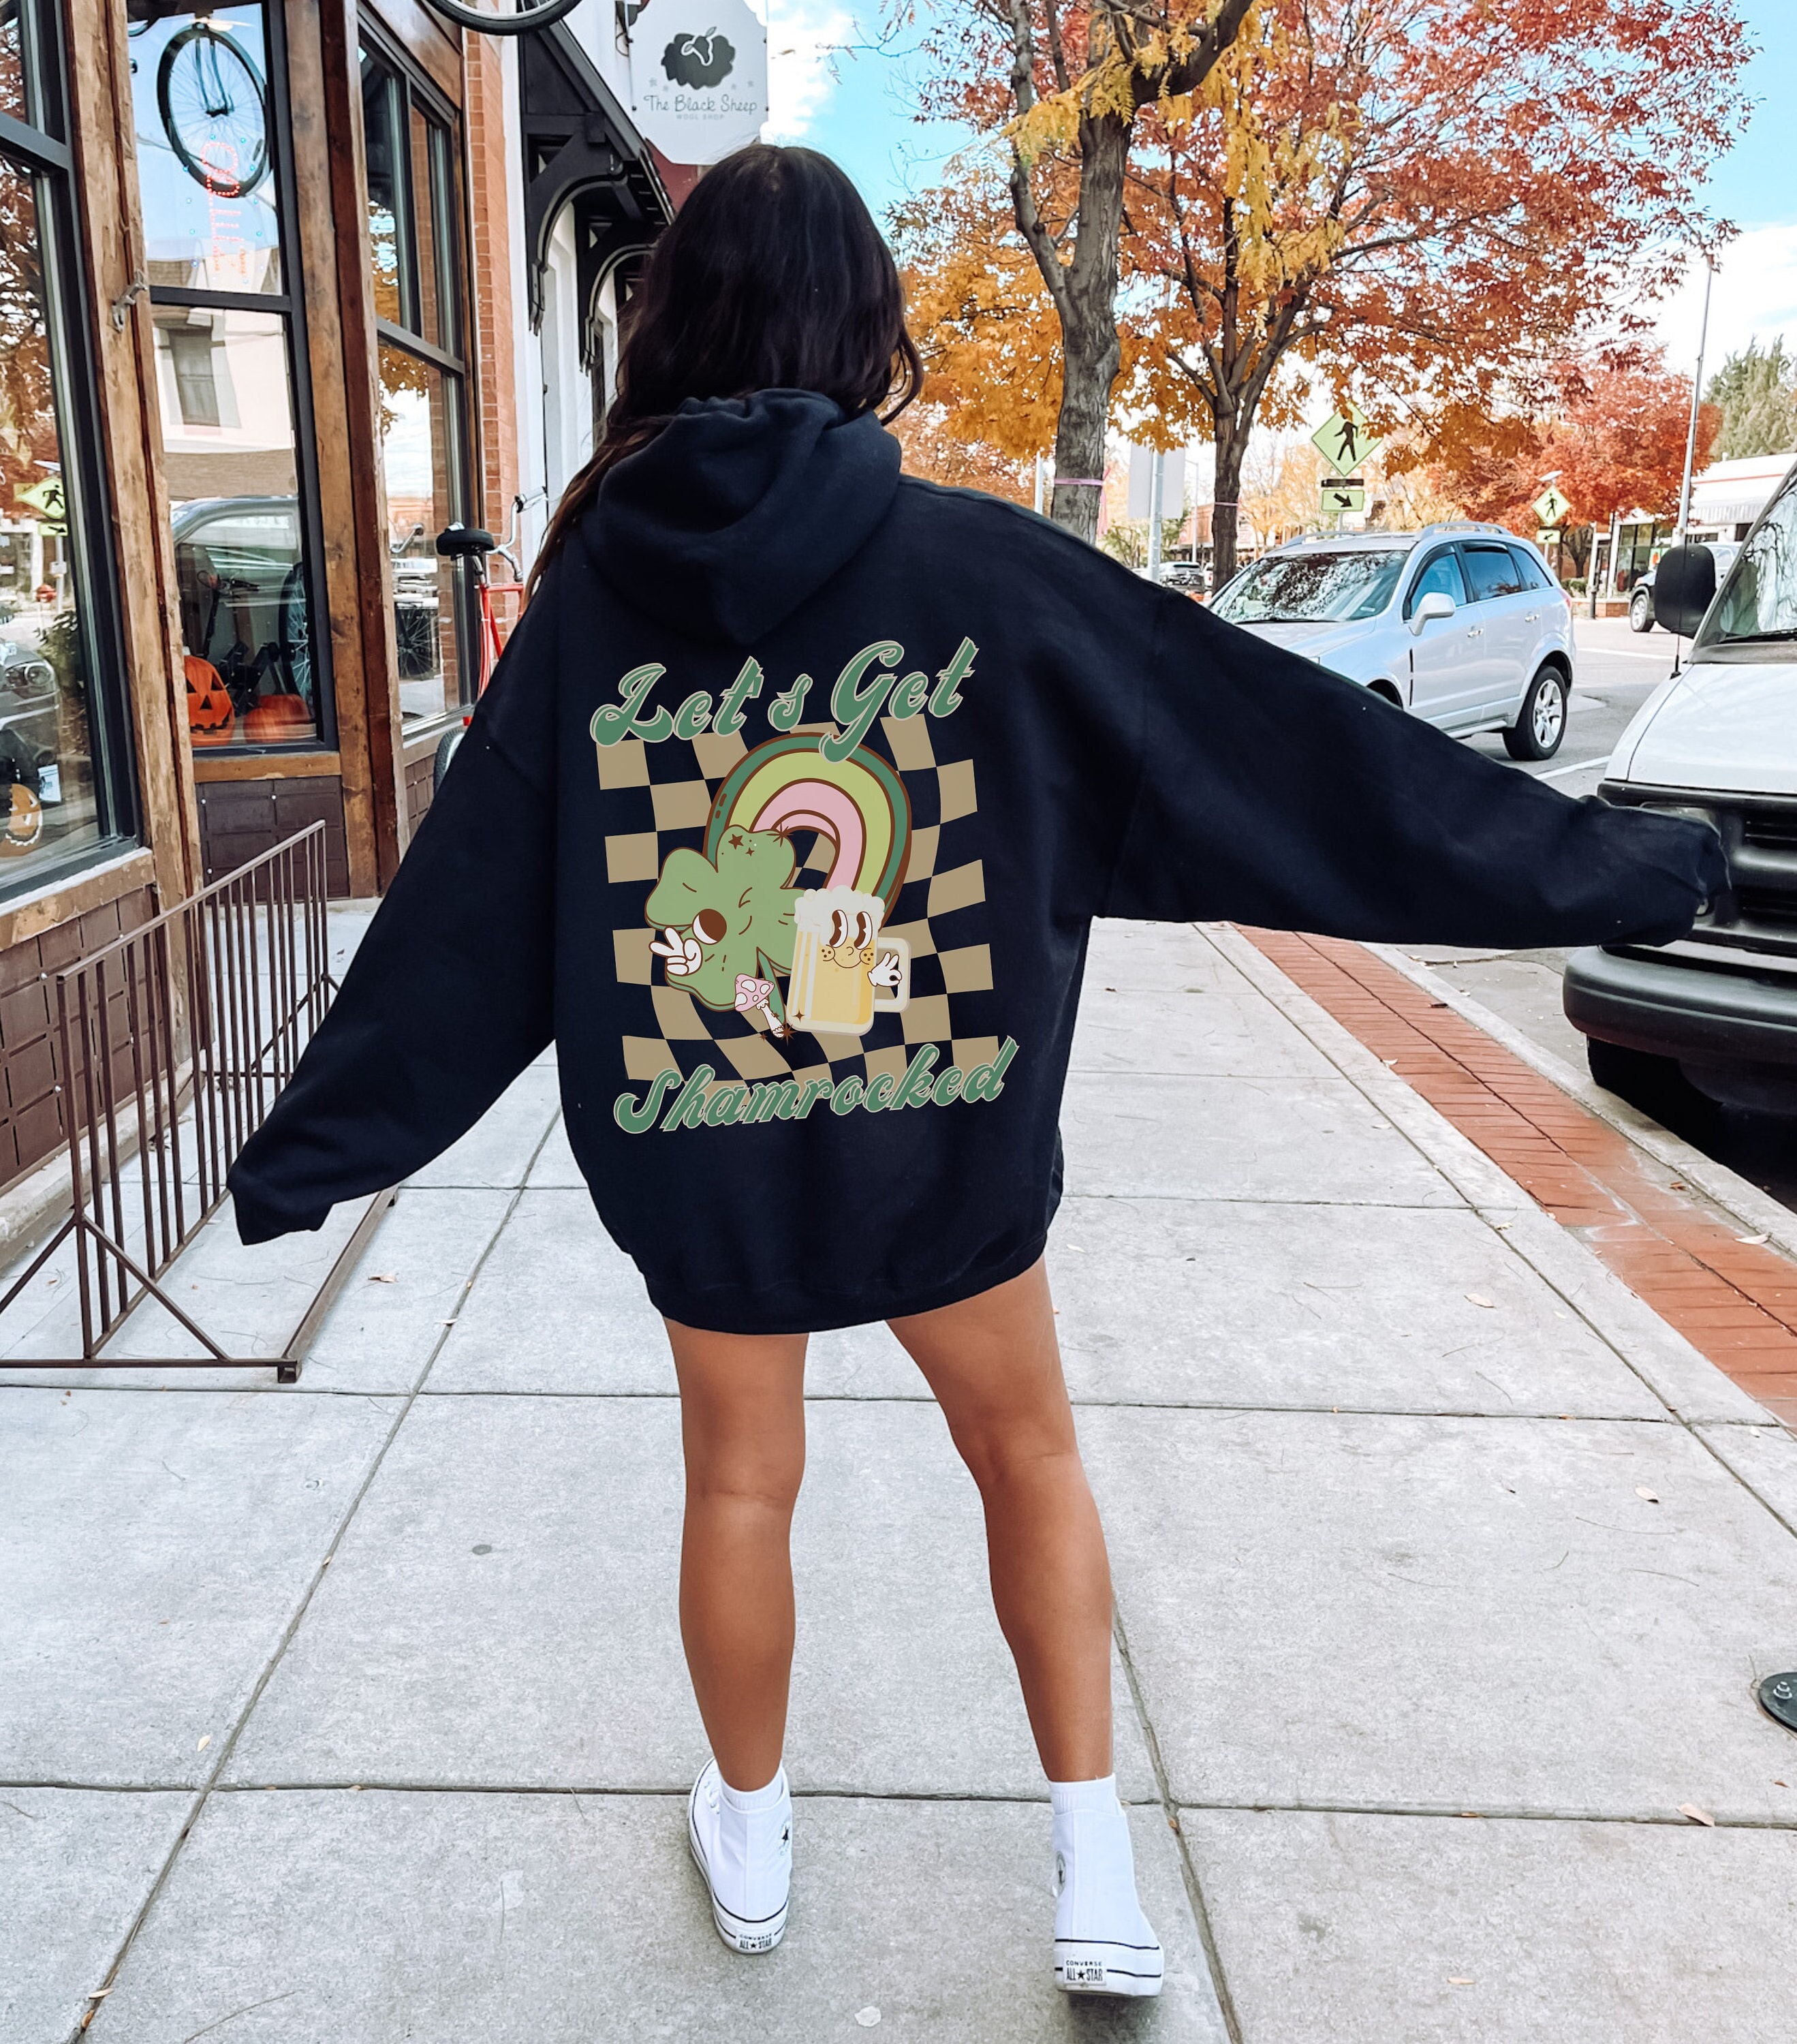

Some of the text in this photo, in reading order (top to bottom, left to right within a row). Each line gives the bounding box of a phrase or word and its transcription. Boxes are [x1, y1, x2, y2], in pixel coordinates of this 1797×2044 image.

[643, 94, 757, 114] The Black Sheep
[590, 636, 980, 763] Let's Get
[613, 1035, 1020, 1134] Shamrocked
[1066, 1967, 1103, 1981] ALL STAR
